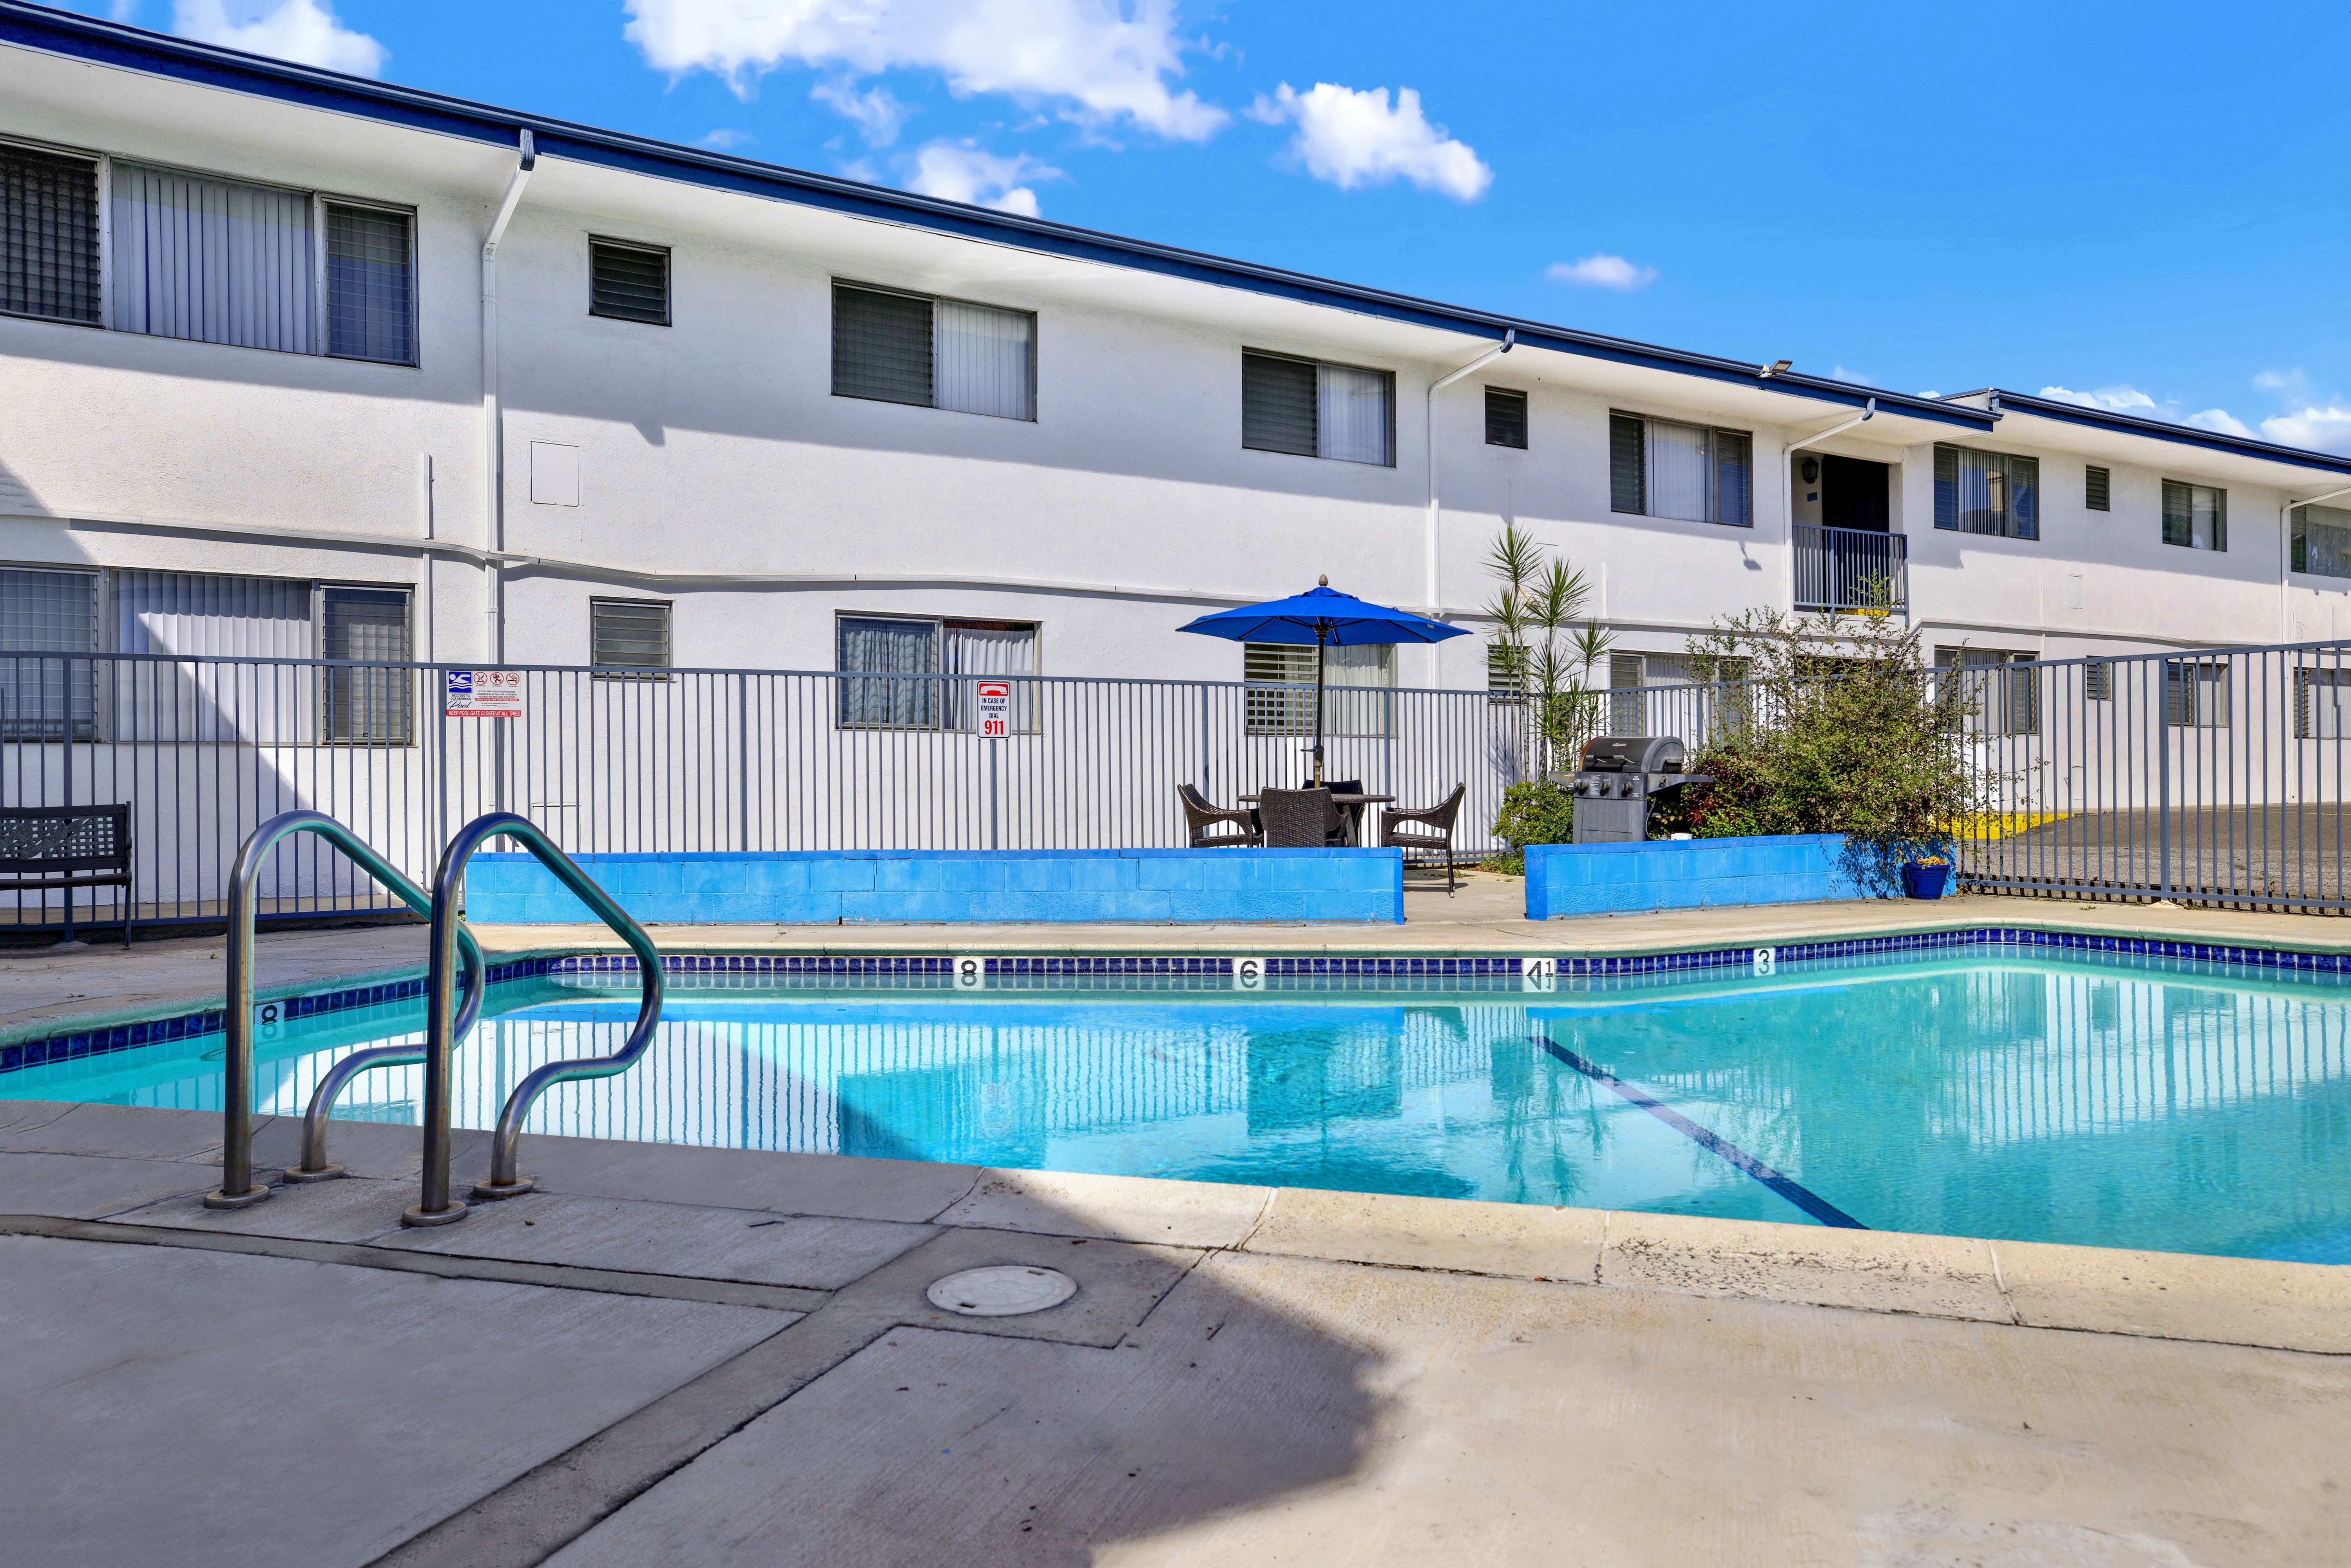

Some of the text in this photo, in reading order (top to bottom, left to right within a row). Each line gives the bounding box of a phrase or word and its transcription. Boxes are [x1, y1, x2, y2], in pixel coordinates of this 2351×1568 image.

[447, 700, 472, 710] Pool
[984, 720, 1003, 735] 911
[1759, 949, 1769, 962] 3
[1240, 960, 1258, 976] 6
